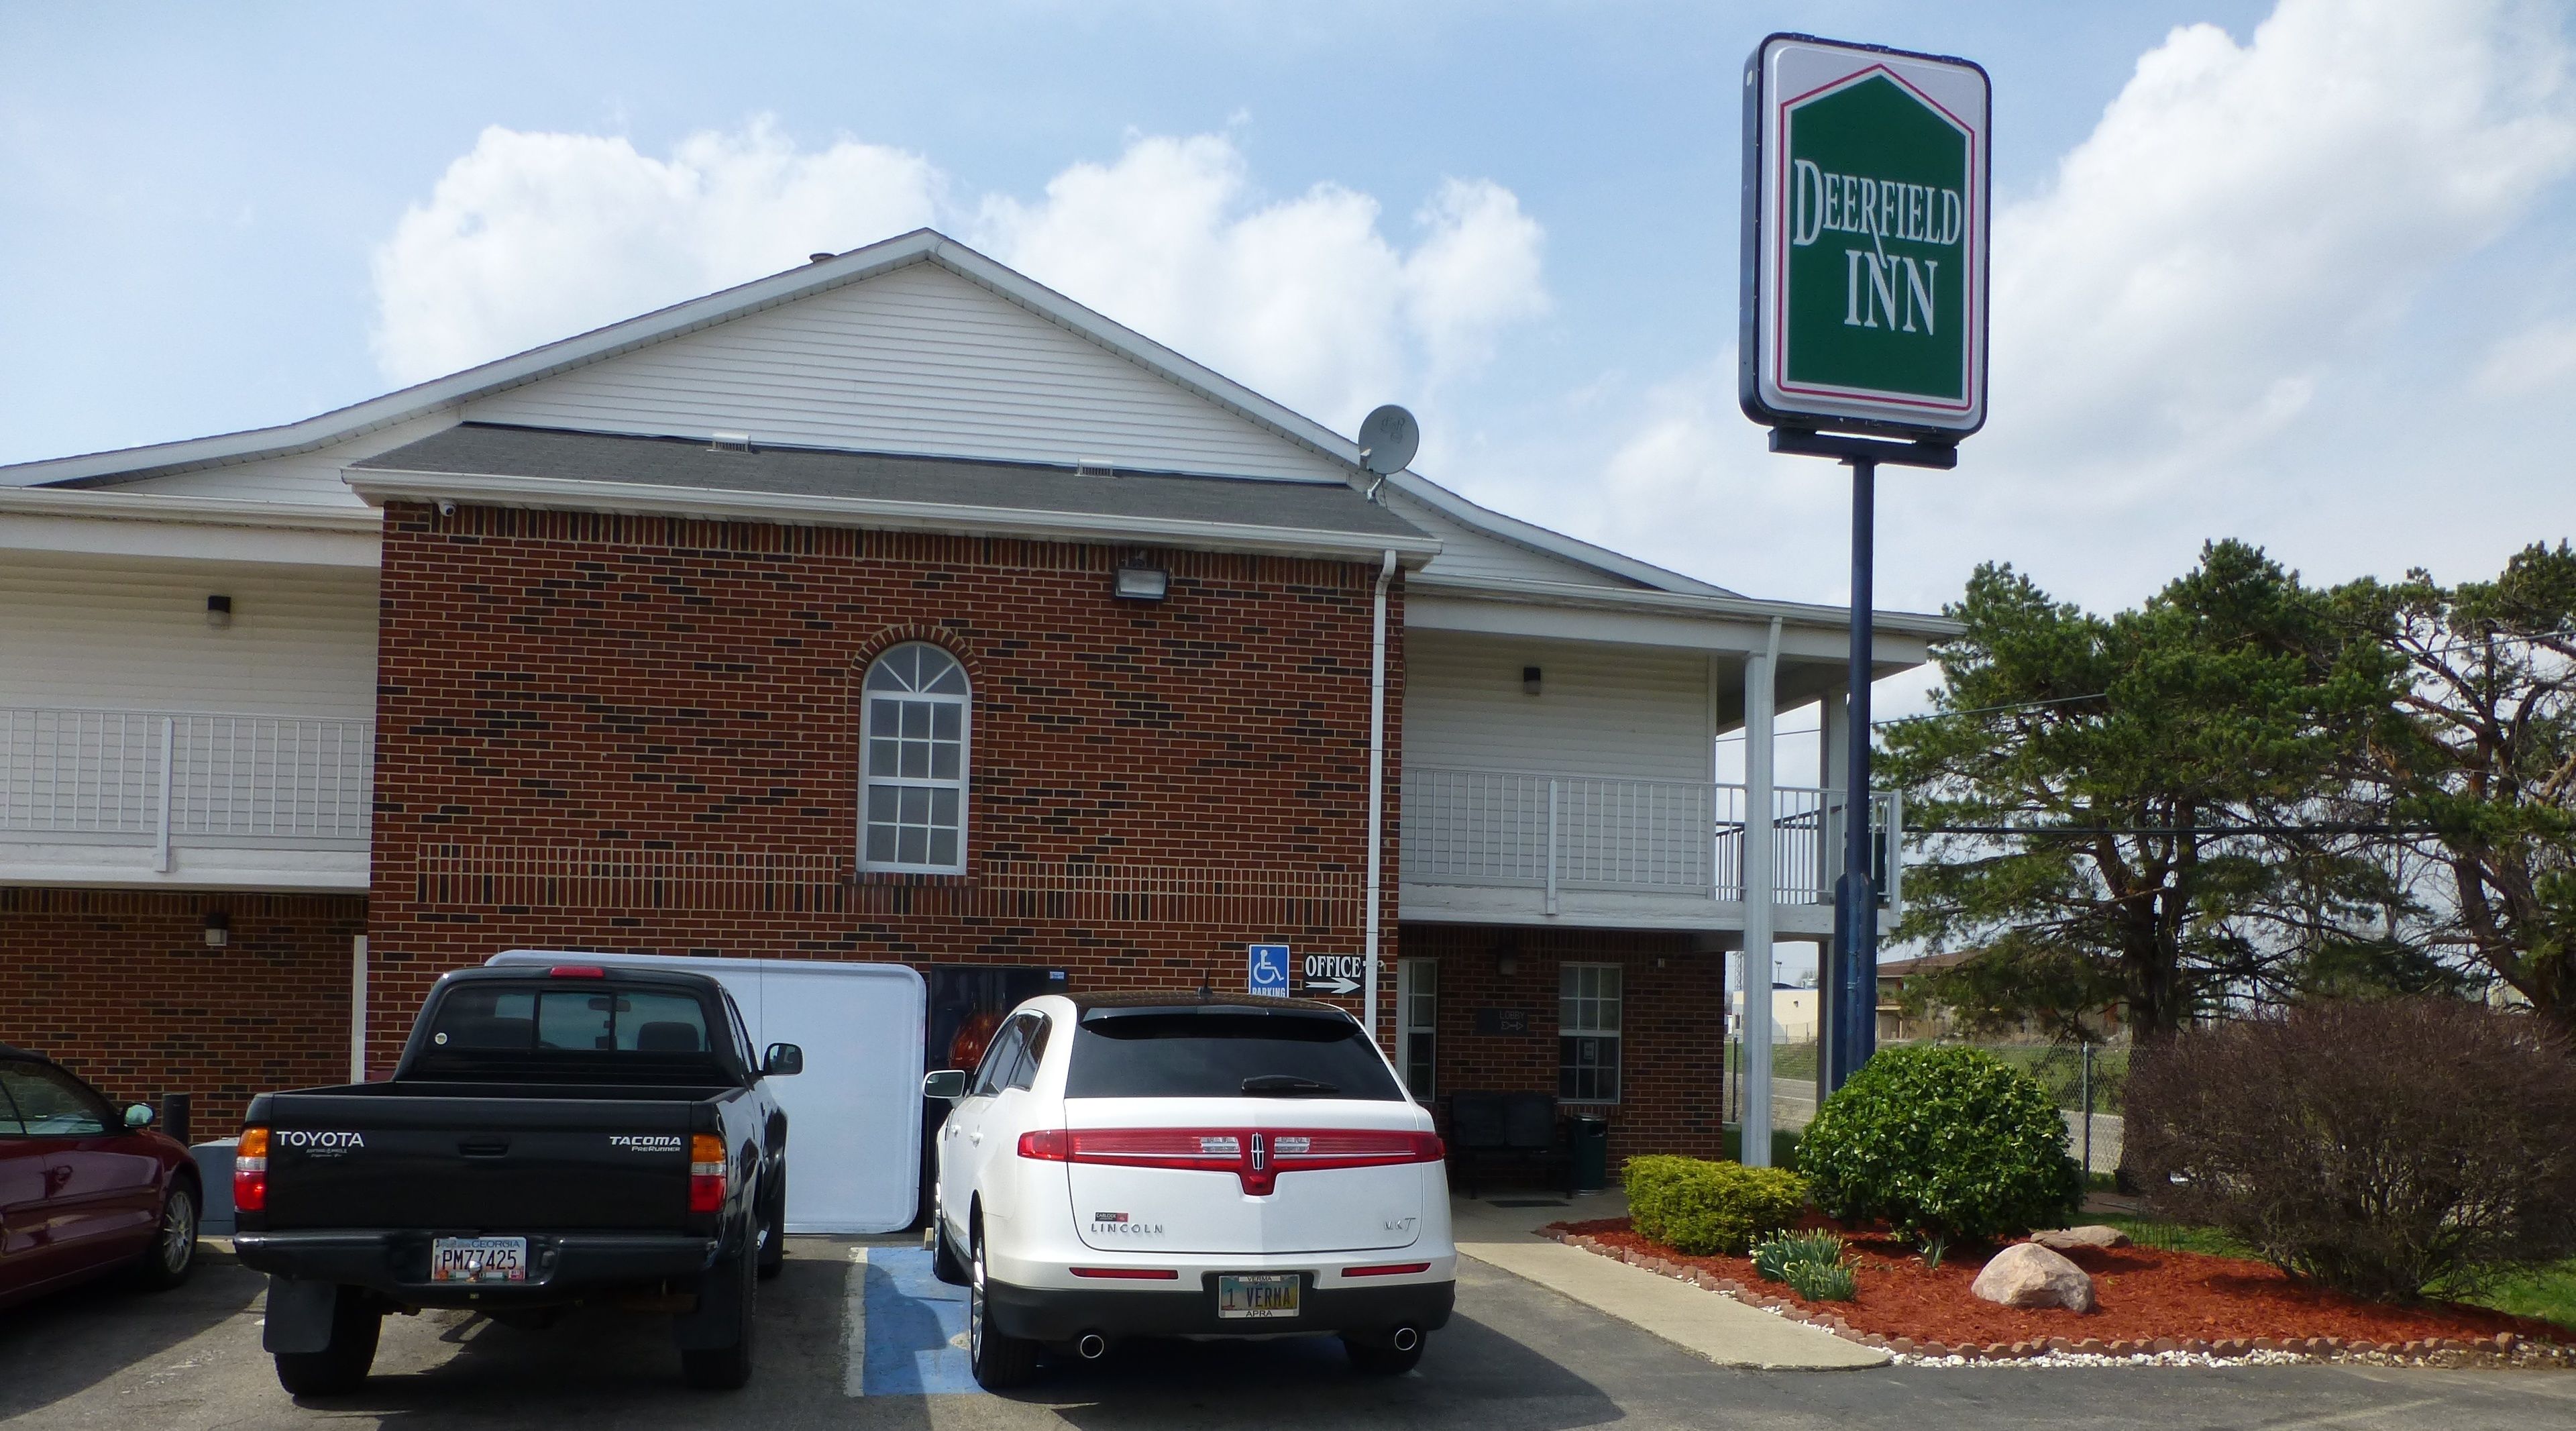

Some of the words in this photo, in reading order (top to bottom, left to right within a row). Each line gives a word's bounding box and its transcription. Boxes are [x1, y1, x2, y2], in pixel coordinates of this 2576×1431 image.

[1793, 158, 1962, 268] DEERFIELD
[1844, 249, 1937, 335] INN
[1305, 955, 1361, 977] OFFICE
[1252, 987, 1285, 997] PARKING
[1499, 1010, 1524, 1020] LOBBY
[276, 1131, 364, 1147] TOYOTA
[609, 1136, 682, 1145] TACOMA
[1091, 1224, 1163, 1233] LINCOLN
[1384, 1218, 1416, 1231] MKT
[471, 1240, 520, 1248] GEORGIA
[1227, 1288, 1233, 1306] 1
[1246, 1287, 1291, 1307] VERMA
